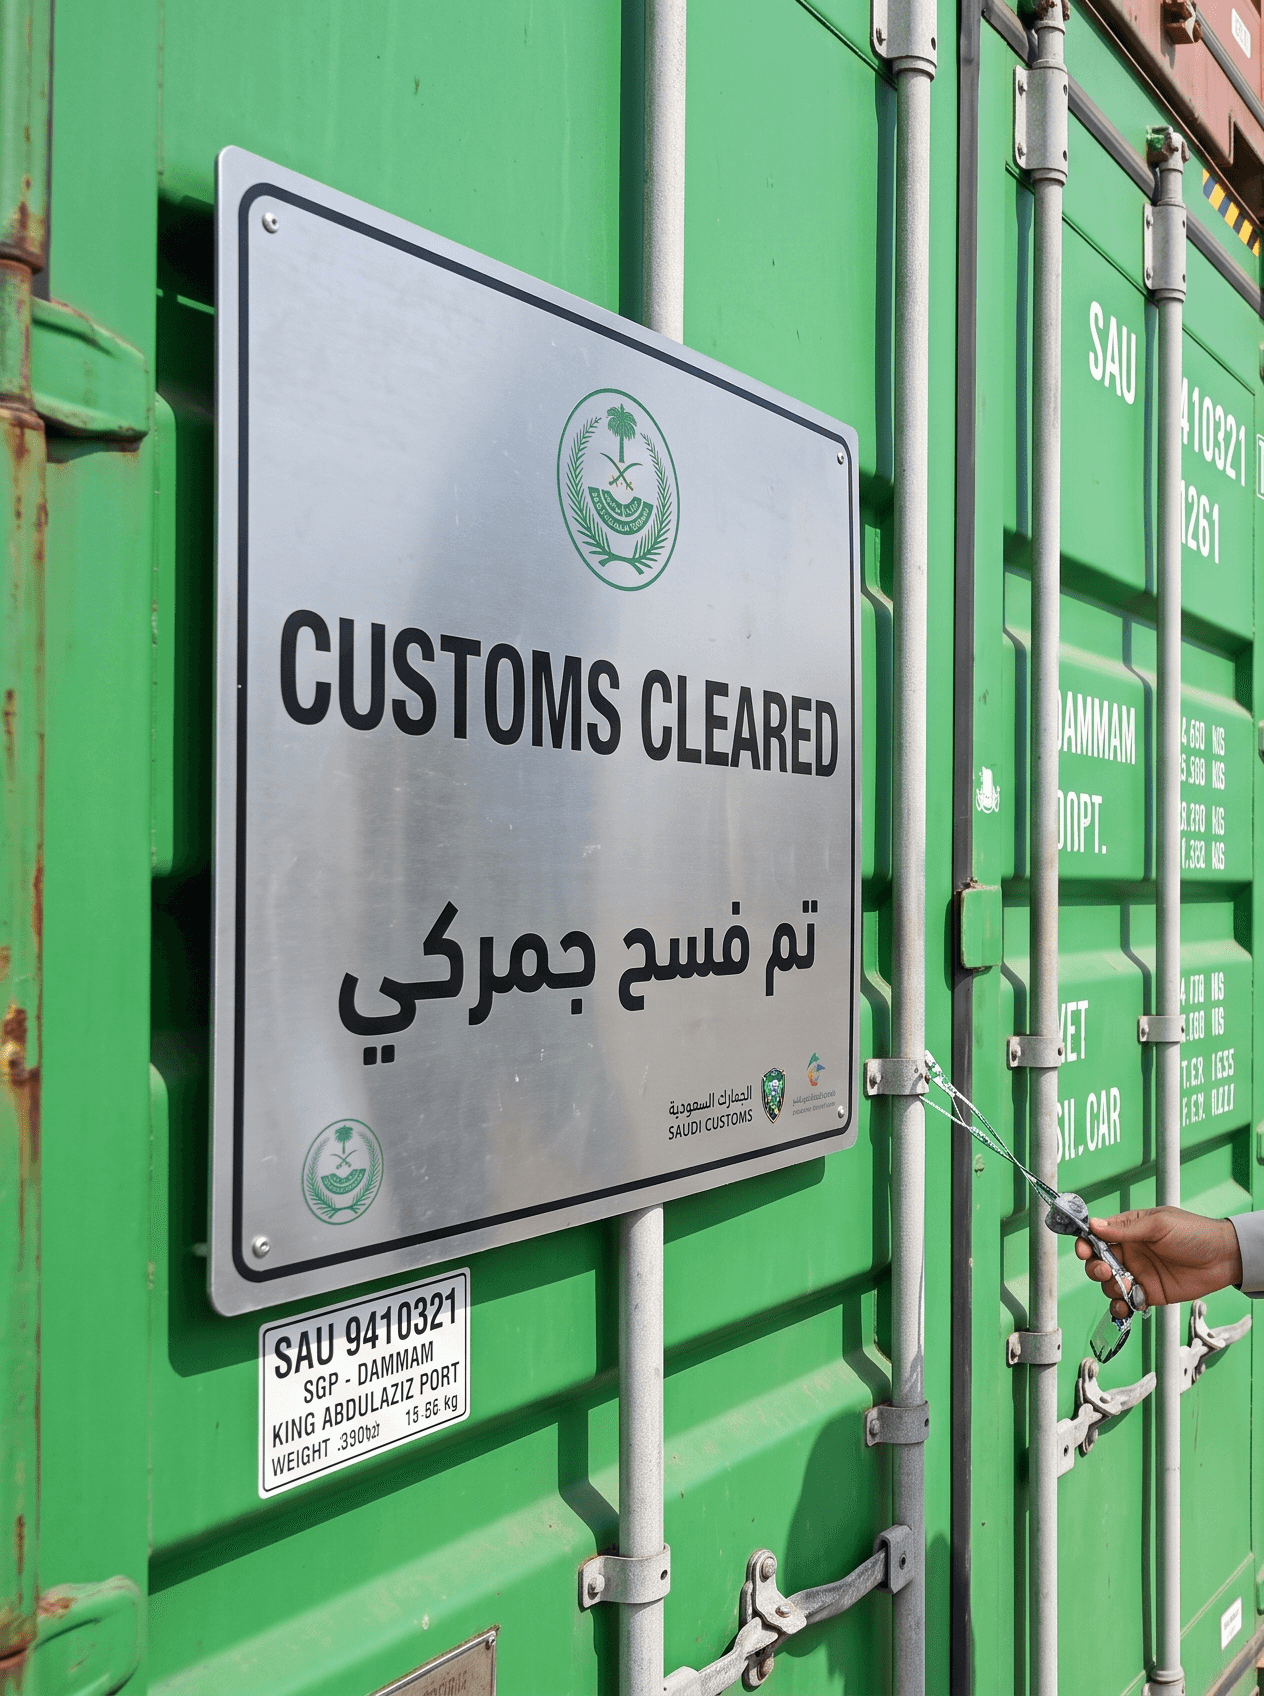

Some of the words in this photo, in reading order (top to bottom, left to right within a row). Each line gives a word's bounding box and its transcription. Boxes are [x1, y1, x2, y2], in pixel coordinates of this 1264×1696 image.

[1089, 300, 1136, 404] SAU
[280, 609, 622, 755] CUSTOMS
[641, 669, 839, 777] CLEARED
[338, 901, 597, 1065] جمركي
[618, 902, 750, 1011] فسح
[765, 900, 818, 996] تم
[668, 1092, 715, 1120] السعودية
[668, 1119, 702, 1140] SAUDI
[704, 1108, 753, 1133] CUSTOMS
[717, 1085, 752, 1110] الجمارك
[274, 1322, 334, 1379] SAU
[345, 1286, 456, 1357] 9410321
[303, 1371, 339, 1404] SGP
[358, 1340, 434, 1386] DAMMAM
[272, 1411, 316, 1449] KING
[322, 1377, 415, 1431] ABDULAZIZ
[419, 1361, 460, 1397] PORT
[271, 1437, 330, 1477] WEIGHT
